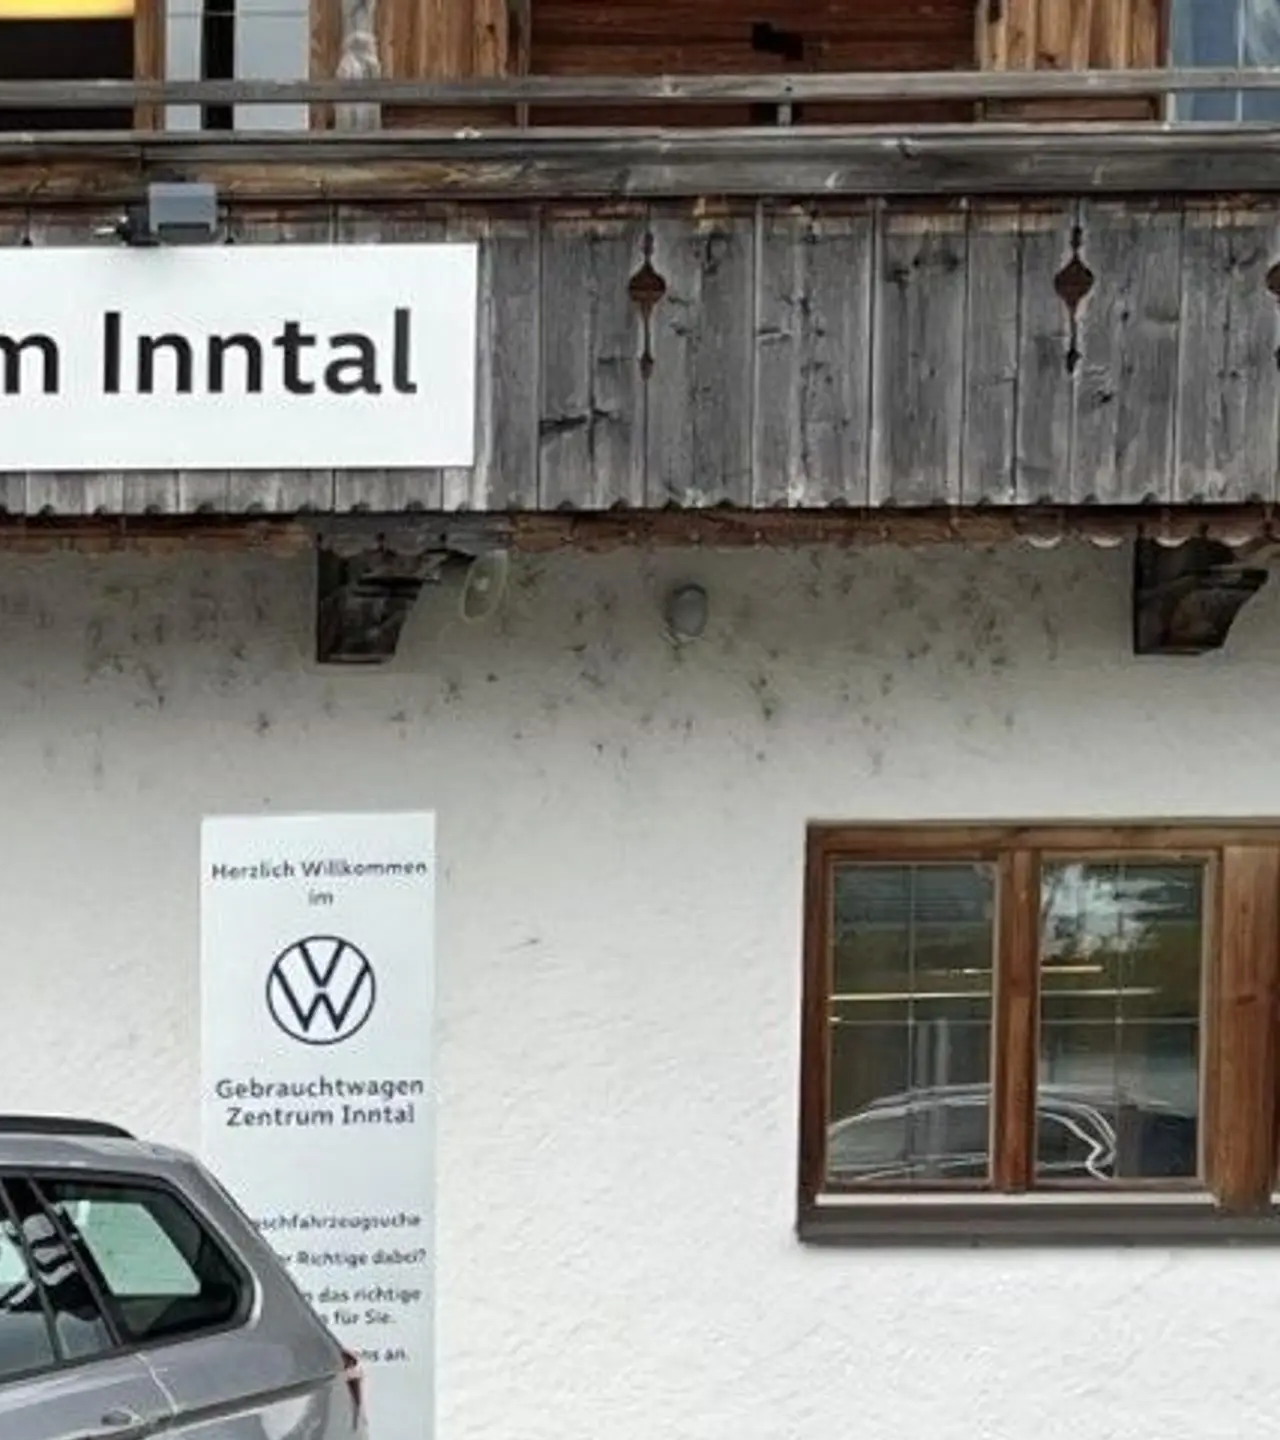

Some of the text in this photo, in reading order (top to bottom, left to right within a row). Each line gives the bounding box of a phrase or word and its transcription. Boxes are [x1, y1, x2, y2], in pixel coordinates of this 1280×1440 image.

[103, 308, 417, 396] Inntal
[211, 860, 428, 880] Herzlich Willkommen
[308, 889, 334, 906] im
[215, 1075, 424, 1101] Gebrauchtwagen
[226, 1104, 415, 1127] Zentrum Inntal
[254, 1212, 422, 1232] schfahrzeugsuche
[296, 1250, 369, 1269] Richtige
[318, 1287, 350, 1303] das
[354, 1286, 422, 1304] richtige
